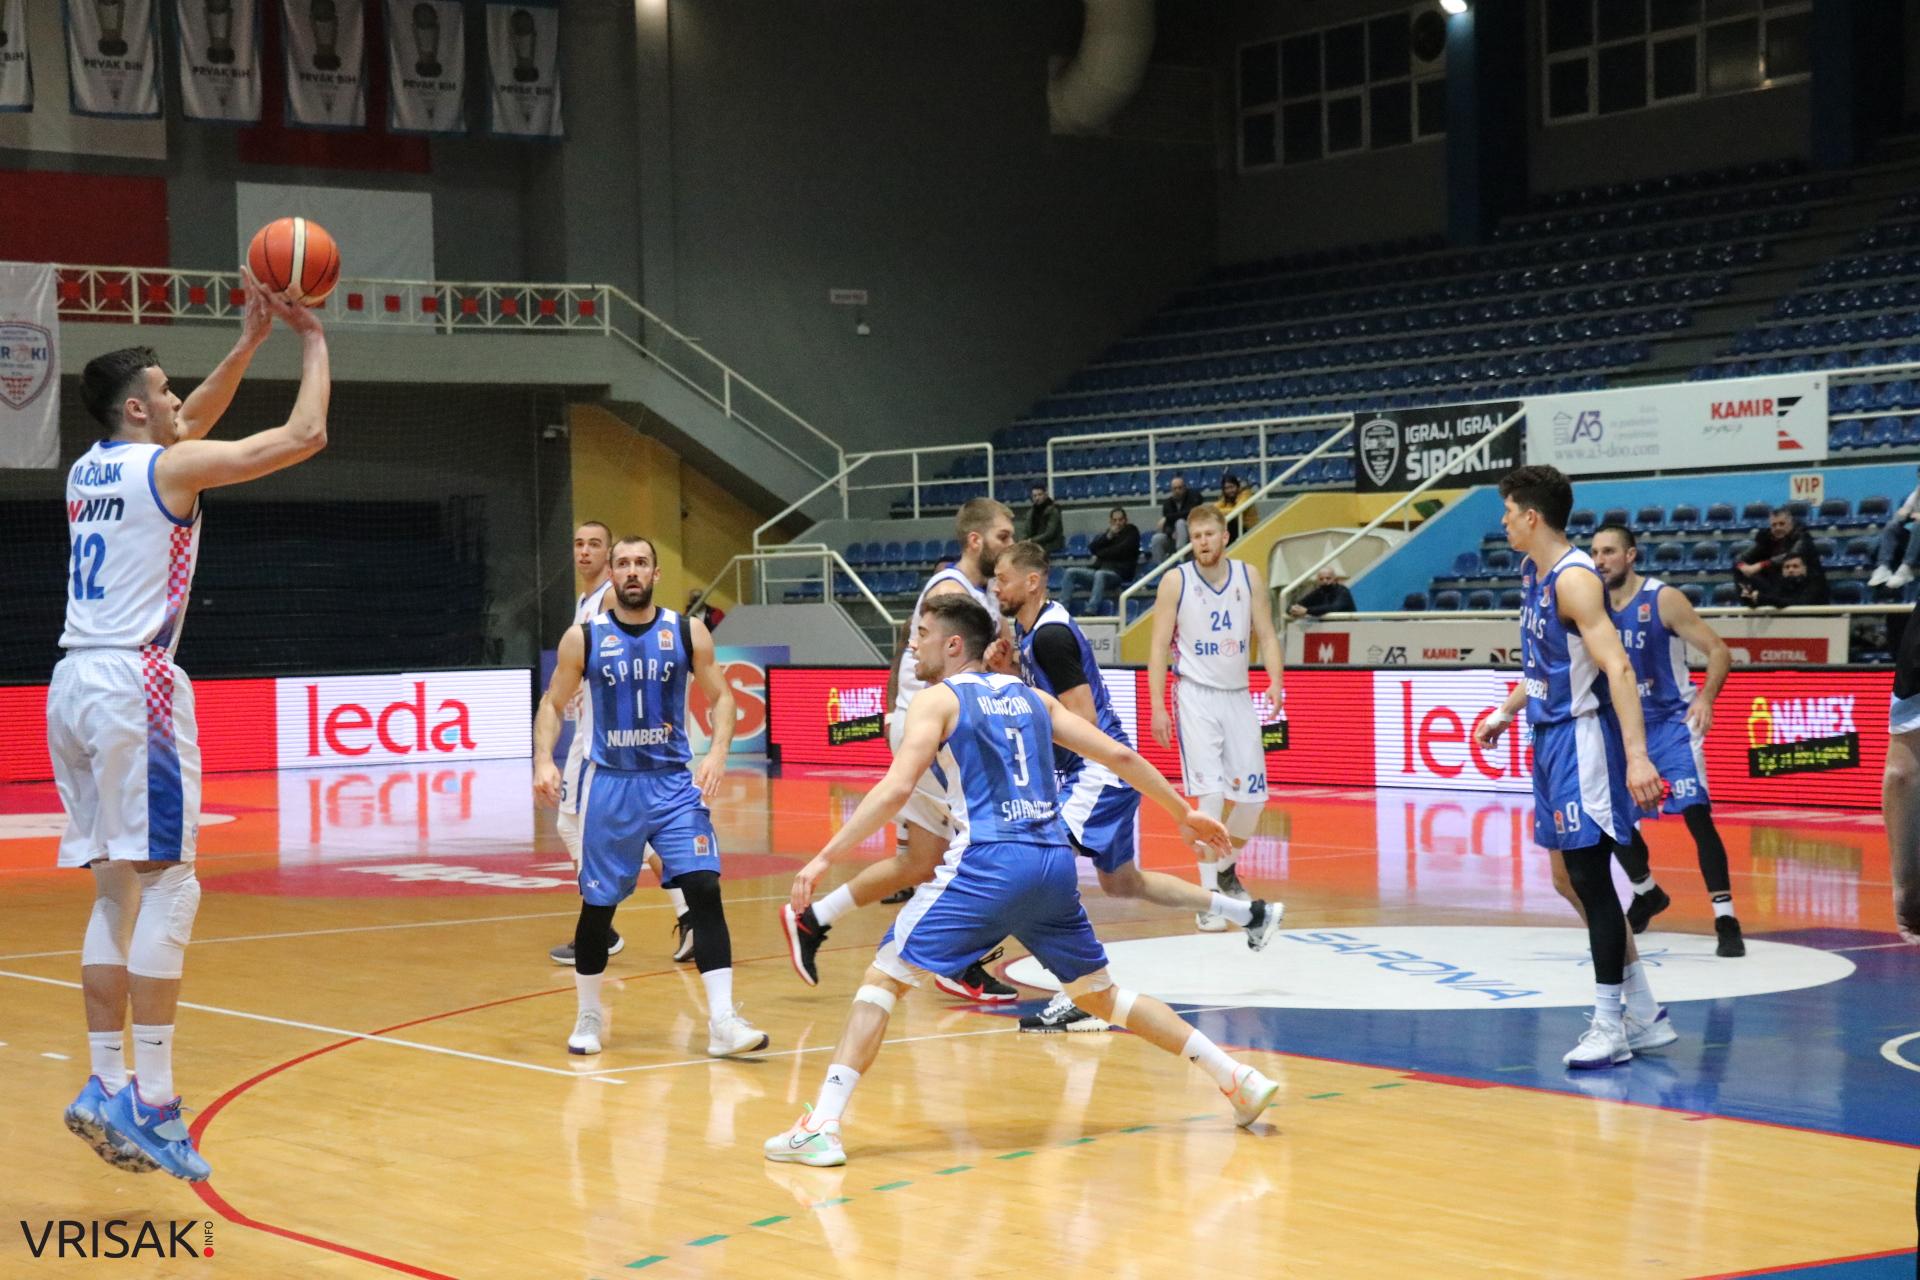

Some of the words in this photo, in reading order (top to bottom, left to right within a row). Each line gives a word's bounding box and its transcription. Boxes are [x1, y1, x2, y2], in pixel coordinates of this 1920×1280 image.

[1711, 398, 1774, 420] KAMIR
[1571, 410, 1604, 443] A3
[1794, 476, 1820, 493] VIP
[73, 533, 106, 600] 12
[1211, 610, 1232, 632] 24
[1423, 648, 1459, 660] KAMIR
[1760, 650, 1808, 662] CENTRAL
[602, 658, 674, 686] SPARS
[304, 681, 479, 757] leda
[637, 689, 643, 719] 1
[1772, 694, 1857, 744] NAMEX
[1399, 679, 1534, 780] led
[1005, 727, 1029, 786] 3
[1248, 773, 1265, 793] 24
[1674, 778, 1697, 800] 95
[1566, 801, 1581, 832] 9
[1281, 933, 1542, 1000] SAPONIA
